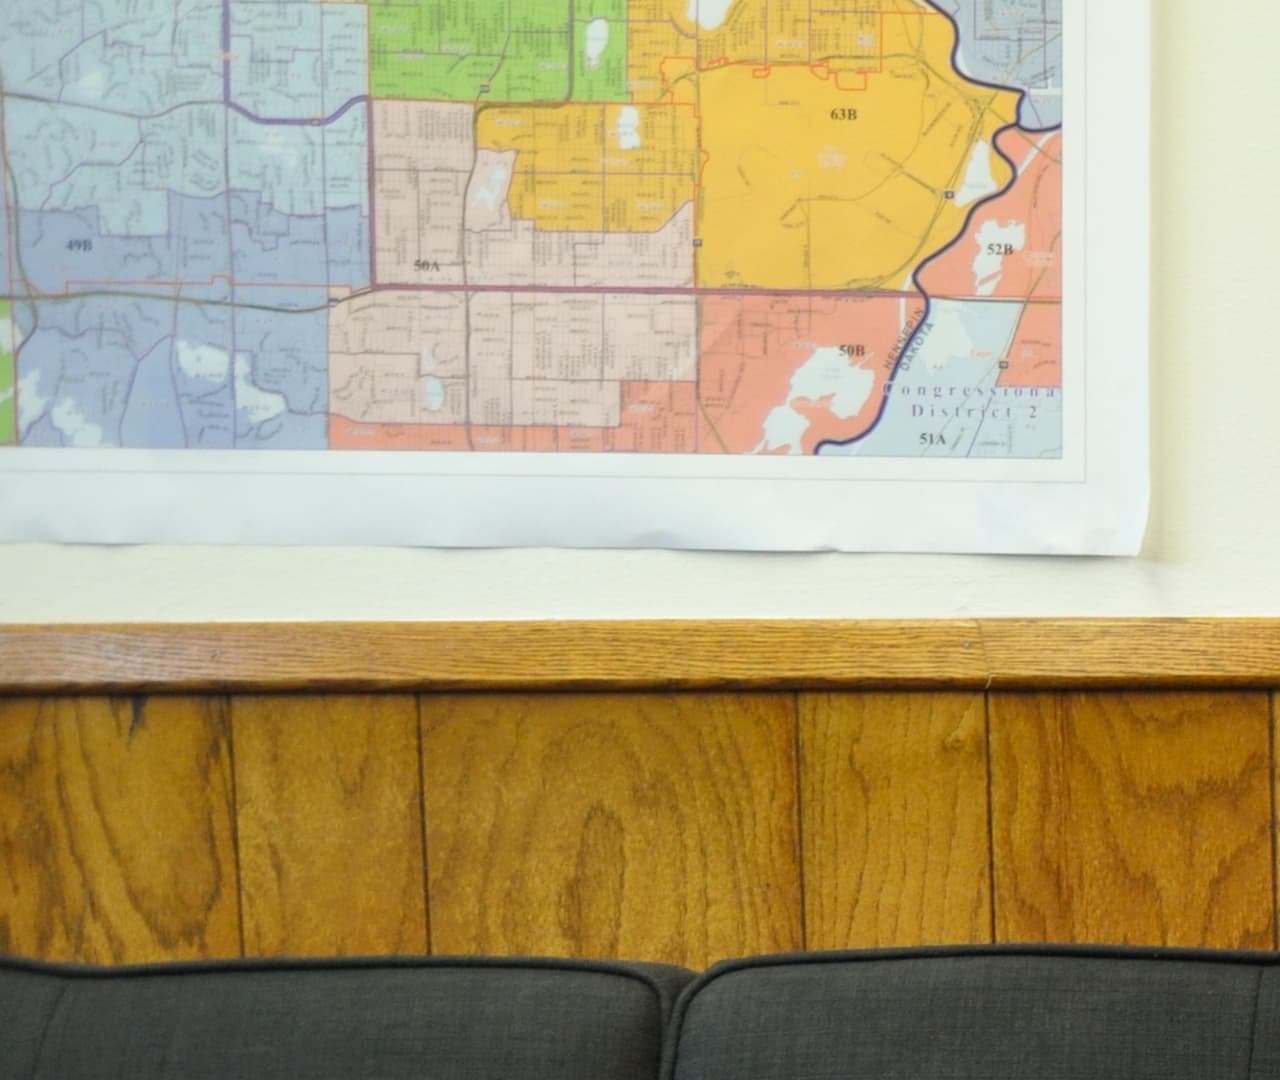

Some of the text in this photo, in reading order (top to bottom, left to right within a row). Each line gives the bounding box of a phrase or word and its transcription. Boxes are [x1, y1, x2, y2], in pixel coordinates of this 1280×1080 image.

[830, 108, 857, 121] 63B
[65, 239, 93, 251] 49B
[987, 243, 1014, 256] 52B
[838, 344, 865, 357] 50B
[900, 322, 936, 372] DAKOTA
[911, 404, 1012, 419] District
[919, 432, 947, 446] 51A
